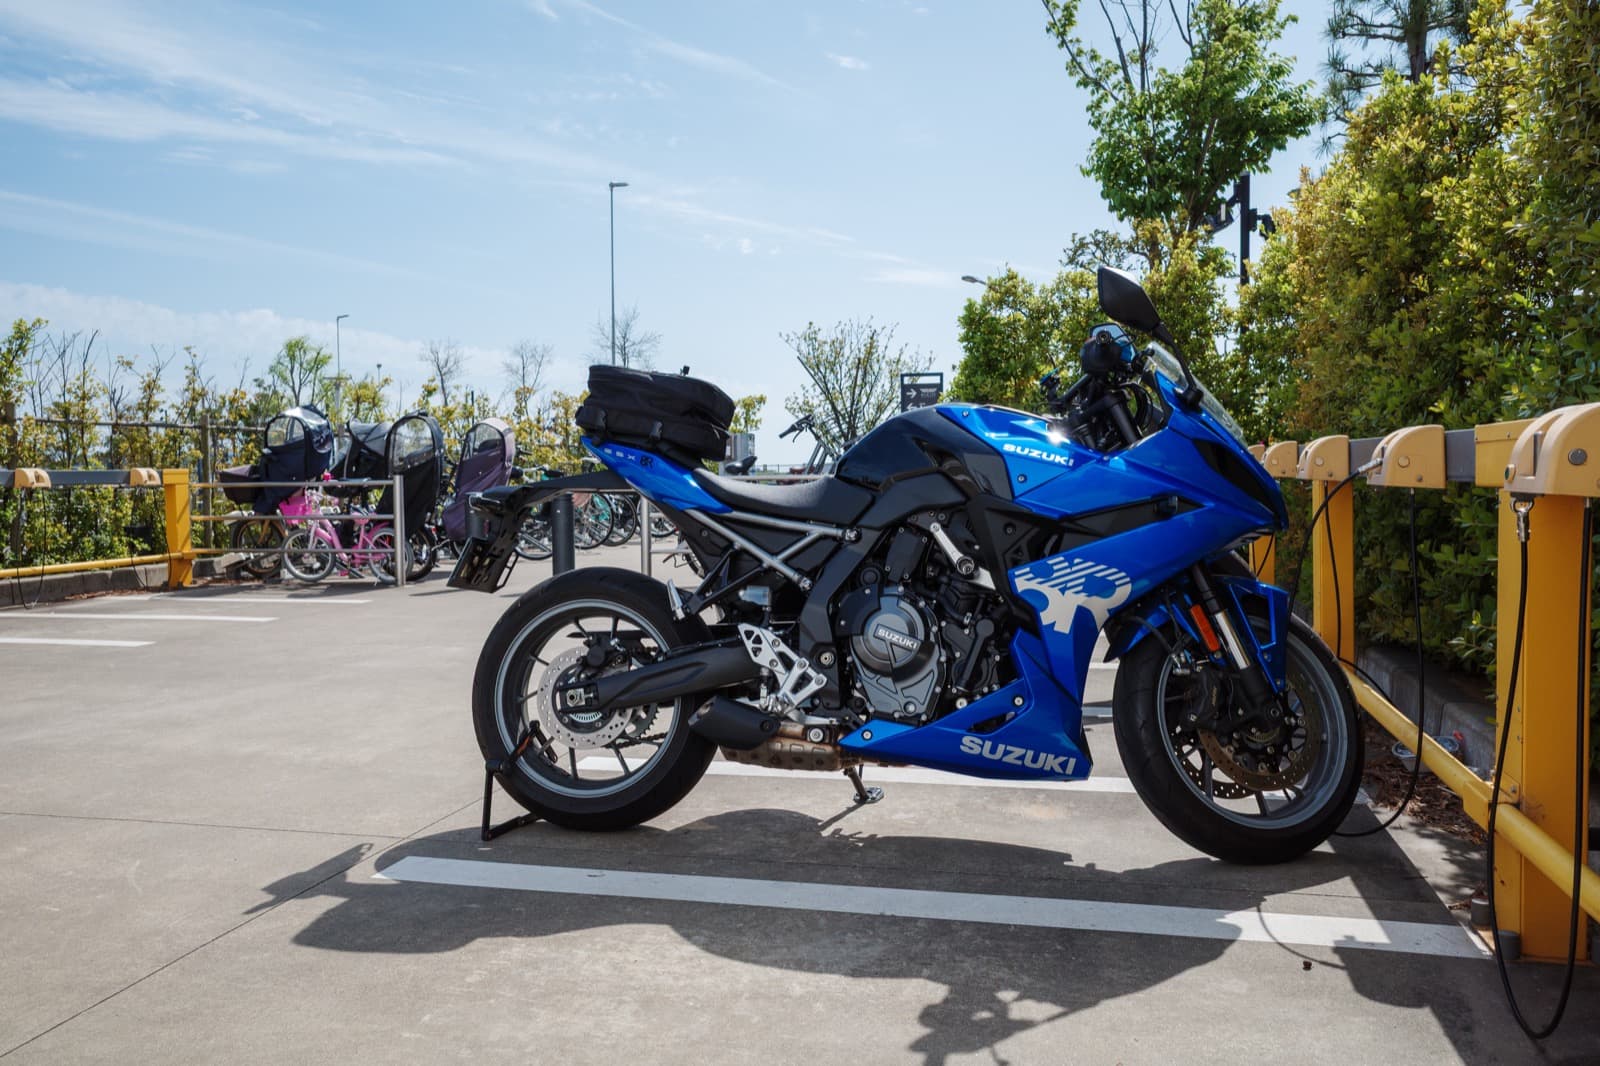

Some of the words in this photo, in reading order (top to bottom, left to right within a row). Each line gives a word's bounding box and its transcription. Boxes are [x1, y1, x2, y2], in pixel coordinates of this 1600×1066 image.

[1003, 443, 1074, 467] SUZUKI
[878, 628, 918, 649] SUZUKI
[959, 735, 1077, 775] SUZUKI
